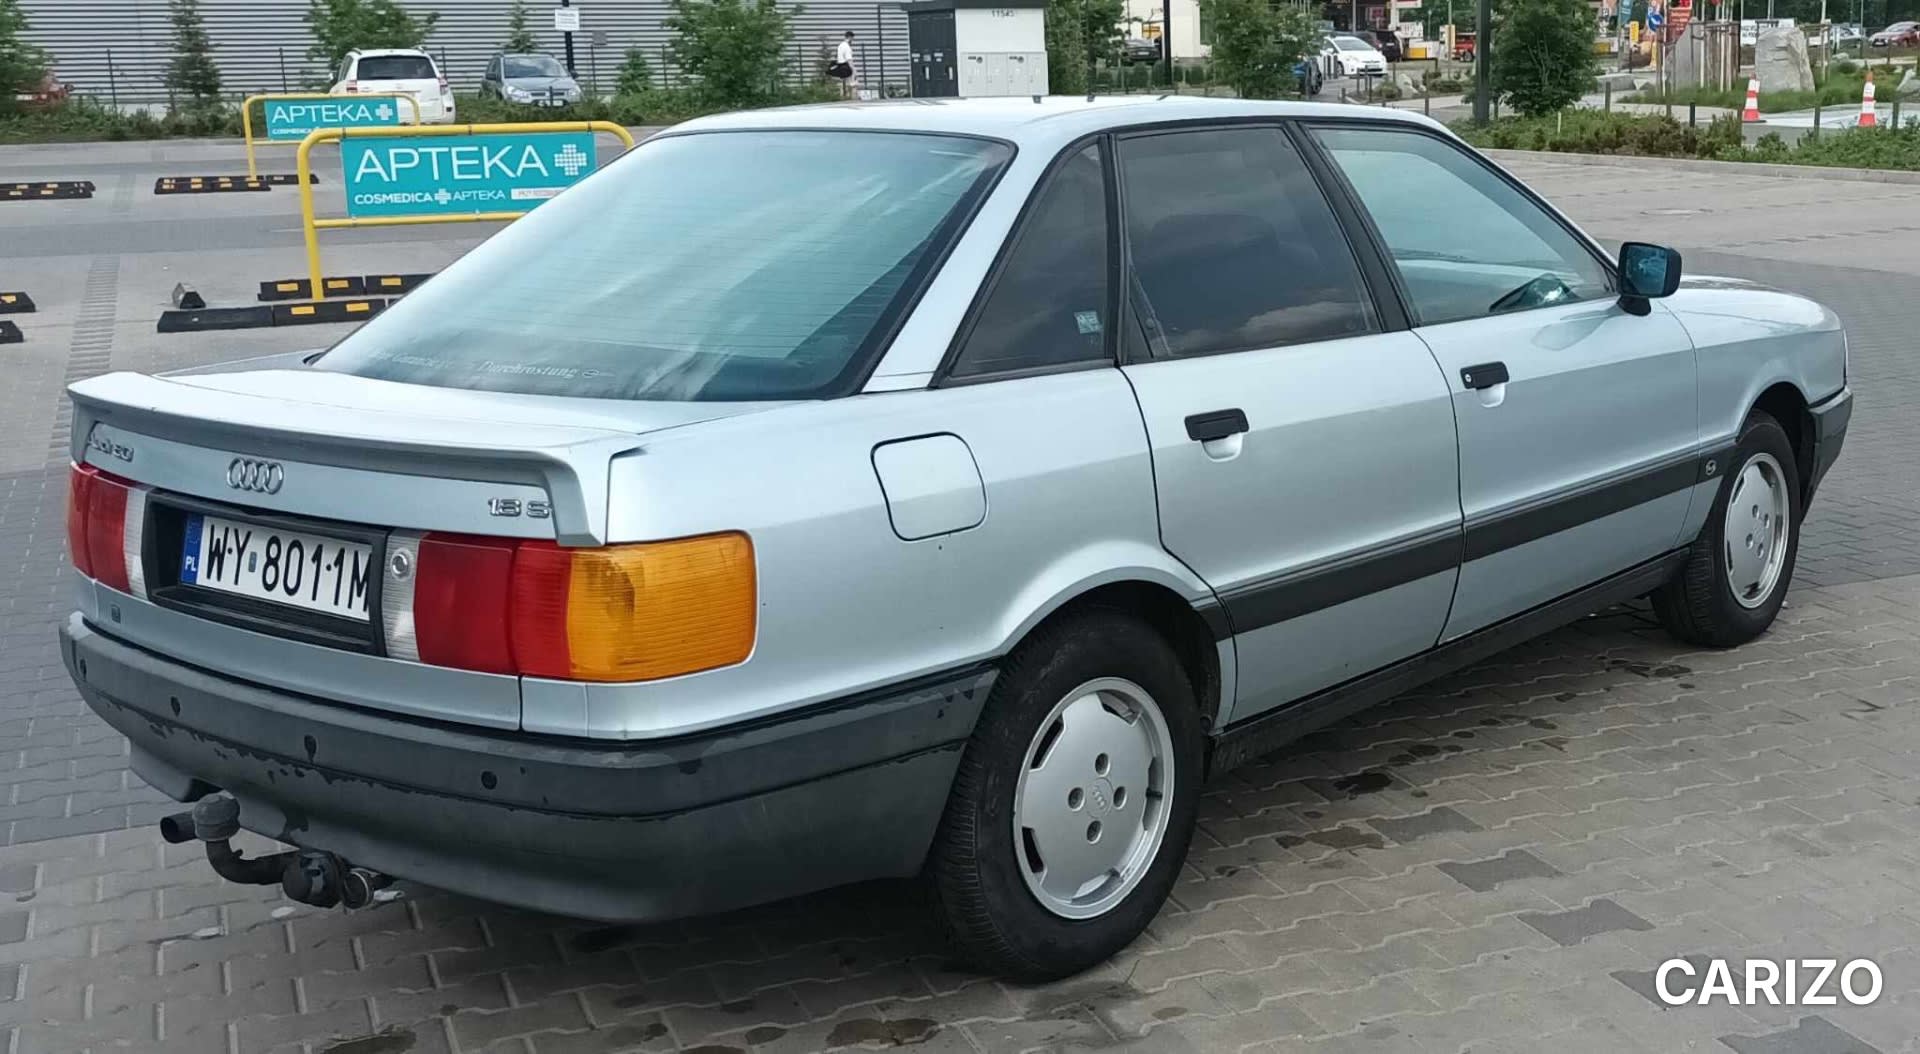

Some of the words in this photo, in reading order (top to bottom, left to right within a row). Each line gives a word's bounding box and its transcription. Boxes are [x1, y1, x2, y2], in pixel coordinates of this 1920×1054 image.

[272, 104, 373, 123] APTEKA
[354, 144, 549, 183] APTEKA
[354, 191, 434, 205] COSMEDICA
[453, 189, 506, 201] APTEKA
[527, 500, 550, 519] S
[184, 556, 197, 572] PL
[206, 524, 252, 586] WY
